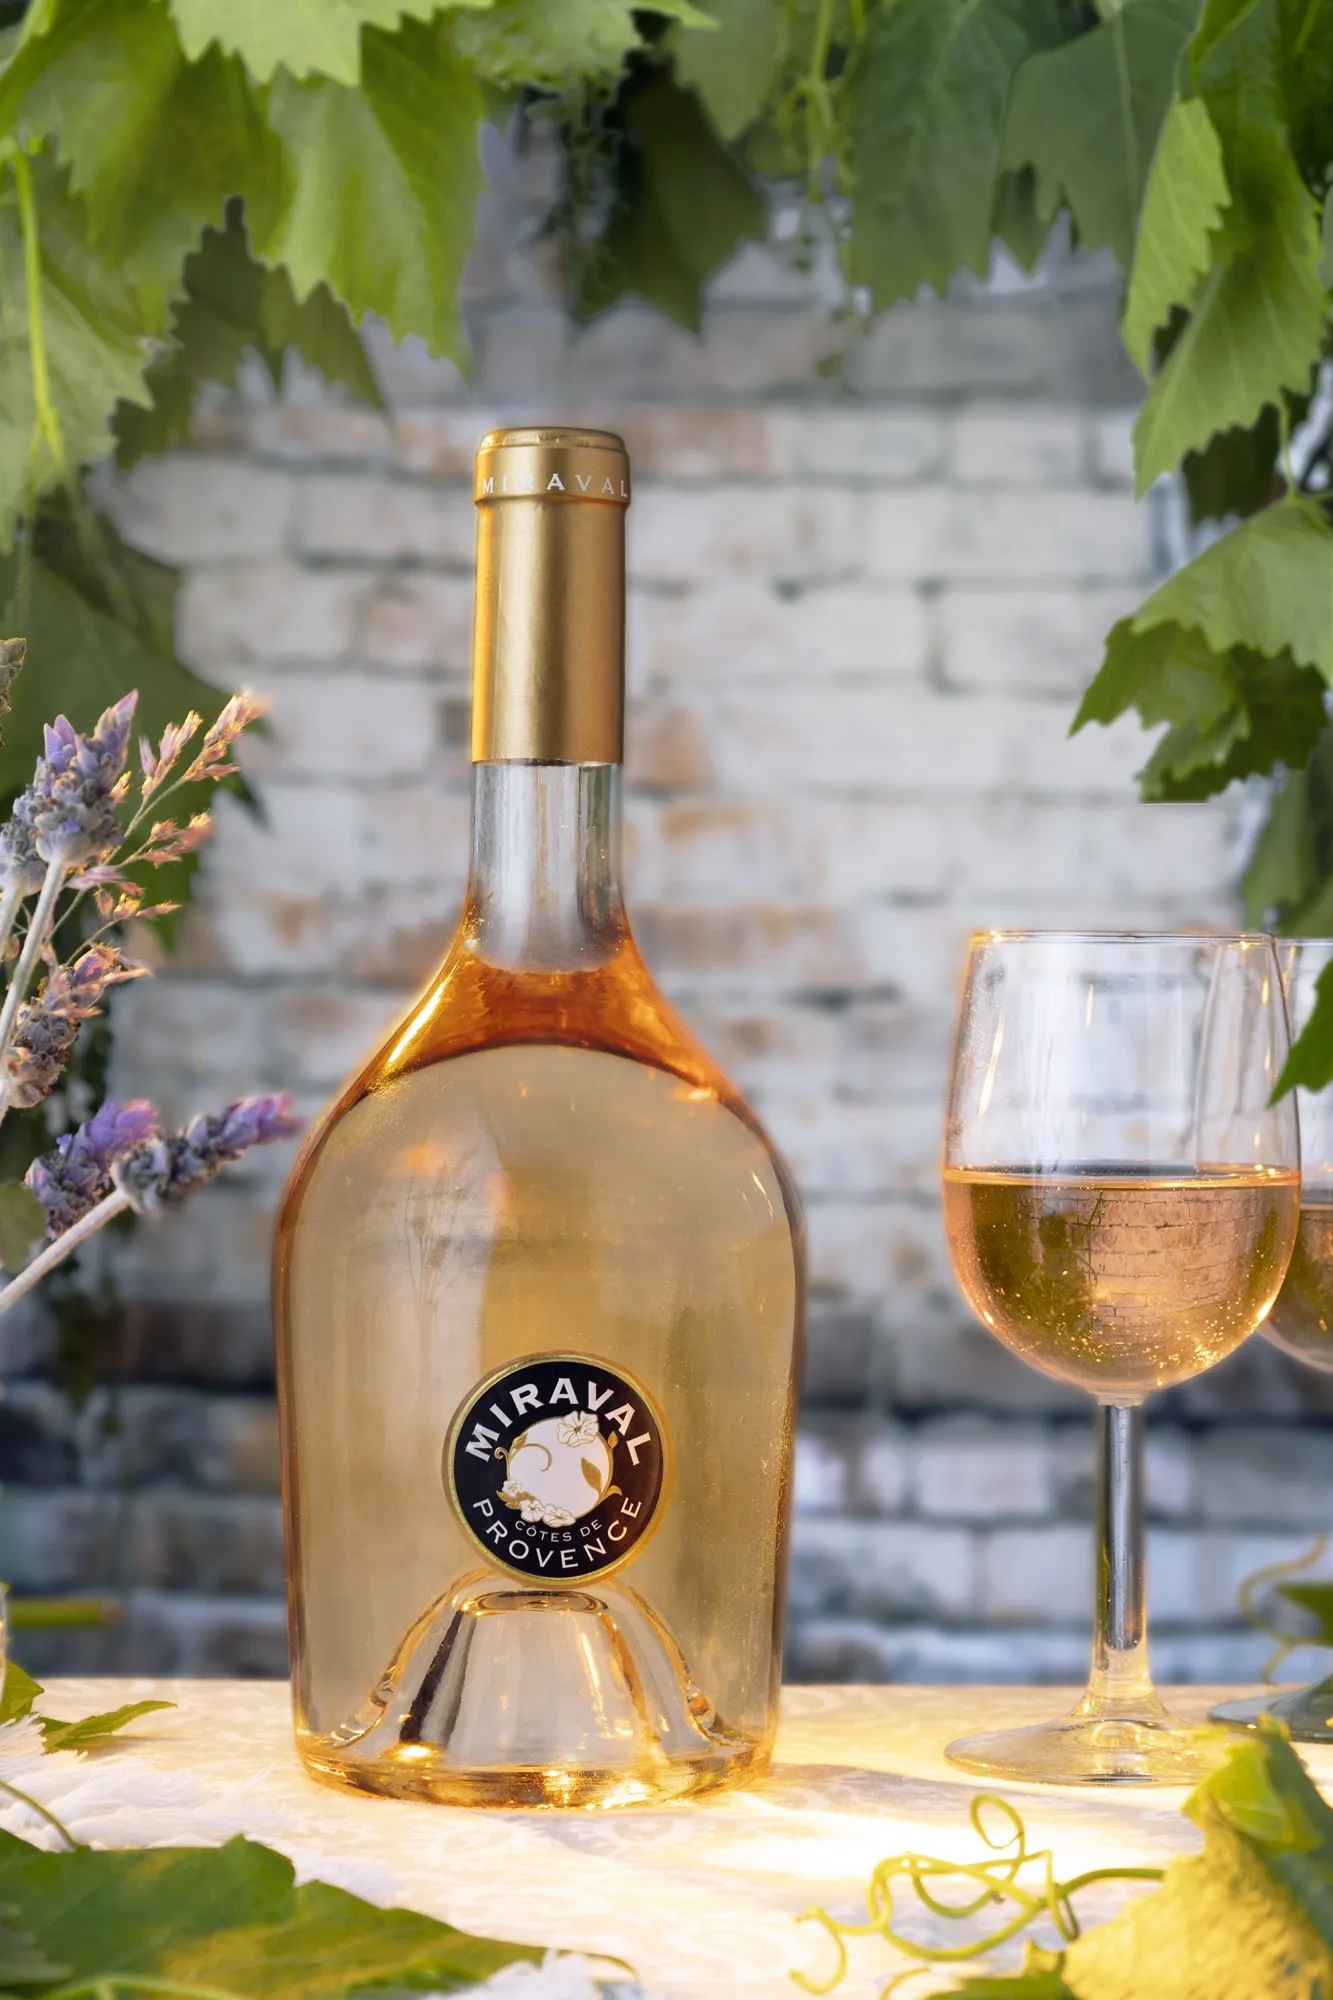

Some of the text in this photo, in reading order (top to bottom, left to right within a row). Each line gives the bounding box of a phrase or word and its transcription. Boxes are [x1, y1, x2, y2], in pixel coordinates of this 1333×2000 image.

[465, 1378, 651, 1465] MIRAVAL
[473, 1497, 642, 1568] PROVENCE
[515, 1519, 602, 1542] CÔTES DE
